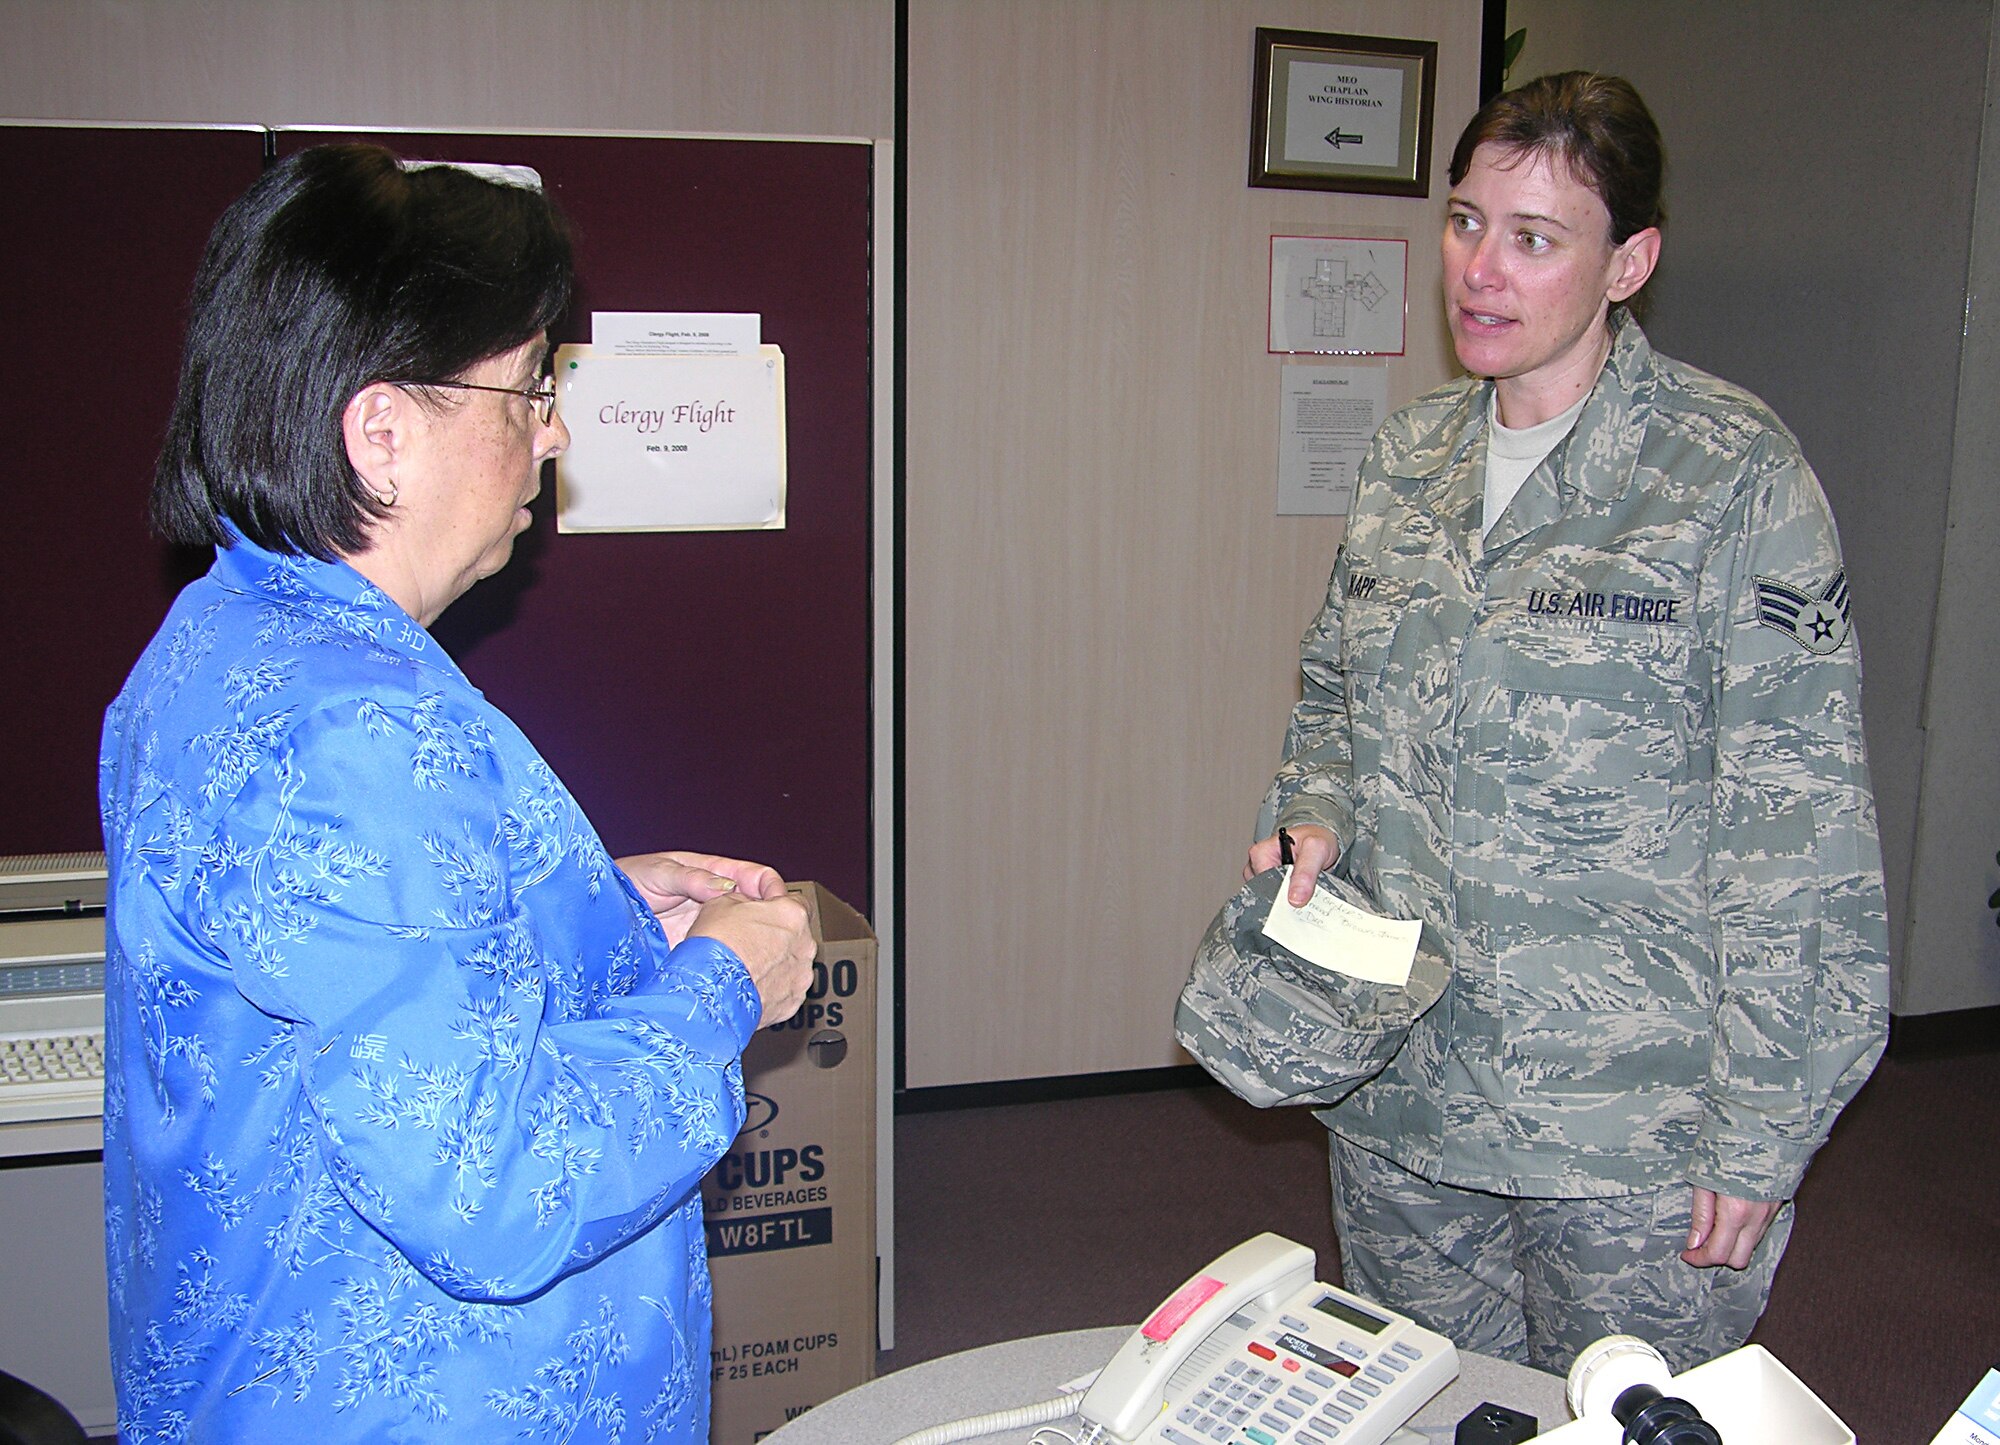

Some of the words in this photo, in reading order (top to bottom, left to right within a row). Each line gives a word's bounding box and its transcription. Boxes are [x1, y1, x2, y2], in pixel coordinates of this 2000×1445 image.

[1323, 85, 1369, 96] CHAPLAIN
[1336, 75, 1358, 85] MEO
[1308, 94, 1333, 104] WING
[1335, 96, 1383, 107] HISTORIAN
[598, 400, 665, 434] Clergy
[671, 399, 736, 433] Flight
[646, 445, 662, 453] Feb.
[671, 445, 688, 453] 2008
[1527, 590, 1563, 616] U.S.
[1567, 591, 1606, 618] AIR
[1610, 593, 1682, 624] FORCE
[769, 1001, 844, 1032] UPS
[716, 1144, 825, 1191] CUPS
[733, 1186, 828, 1211] BEVERAGES
[719, 1218, 812, 1249] W8FTL
[742, 1339, 790, 1360] FOAM
[793, 1333, 839, 1353] CUPS
[711, 1367, 725, 1381] F
[729, 1364, 748, 1380] 25
[752, 1358, 799, 1377] EACH
